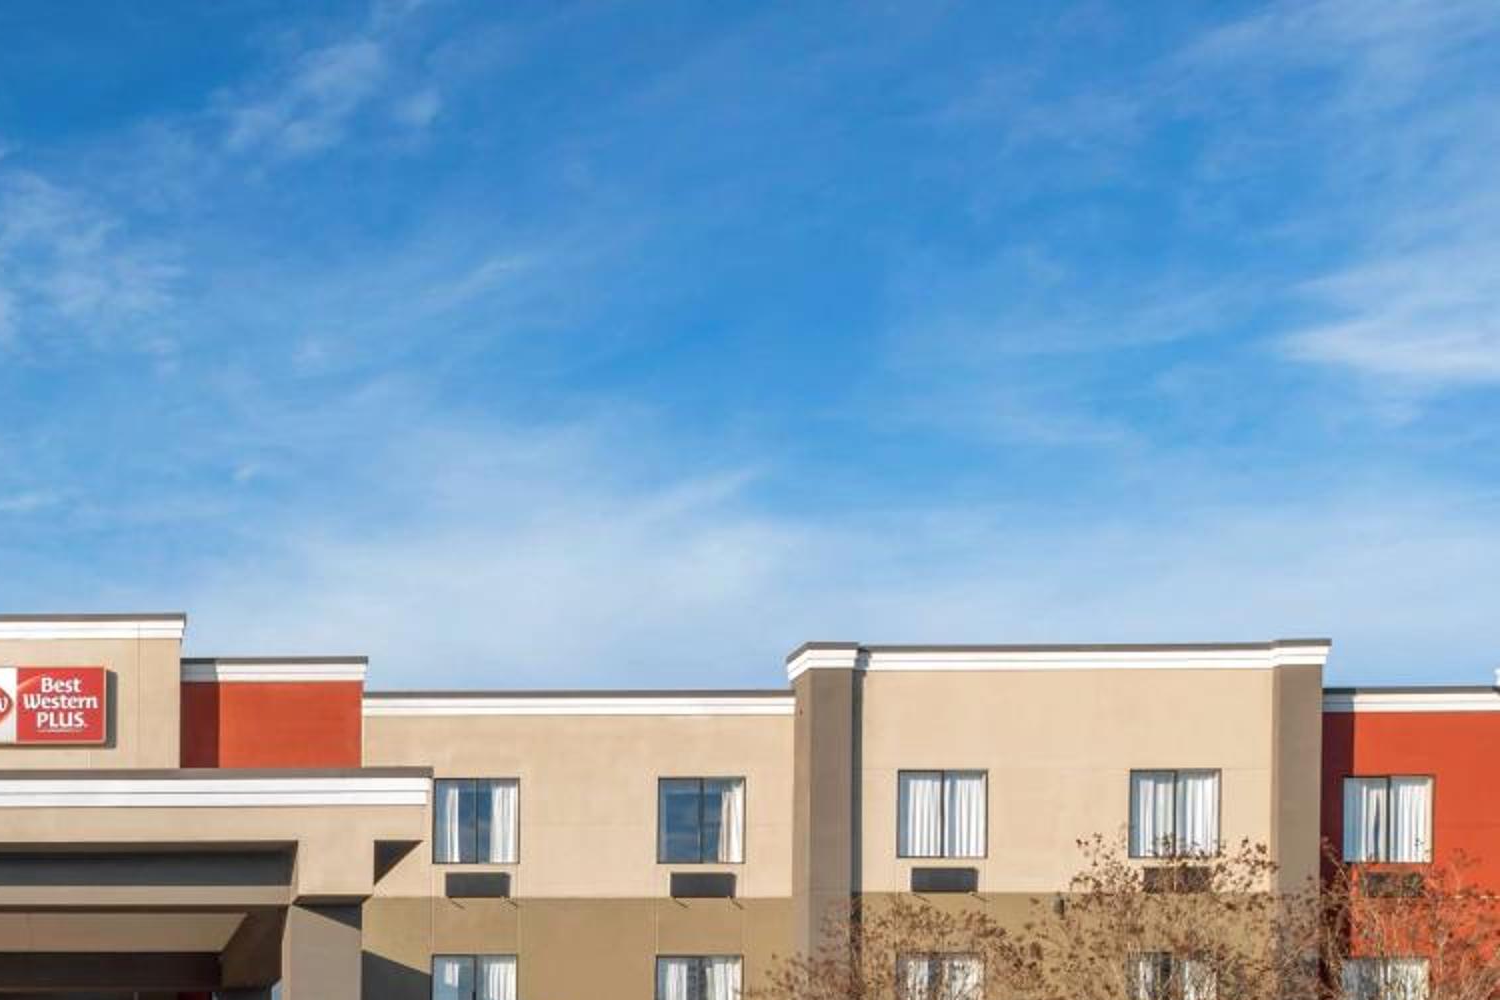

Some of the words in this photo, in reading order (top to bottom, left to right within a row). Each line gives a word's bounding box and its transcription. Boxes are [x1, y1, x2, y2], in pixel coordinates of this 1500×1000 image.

[41, 677, 82, 693] Best
[23, 693, 99, 709] Western
[37, 712, 84, 728] PLUS
